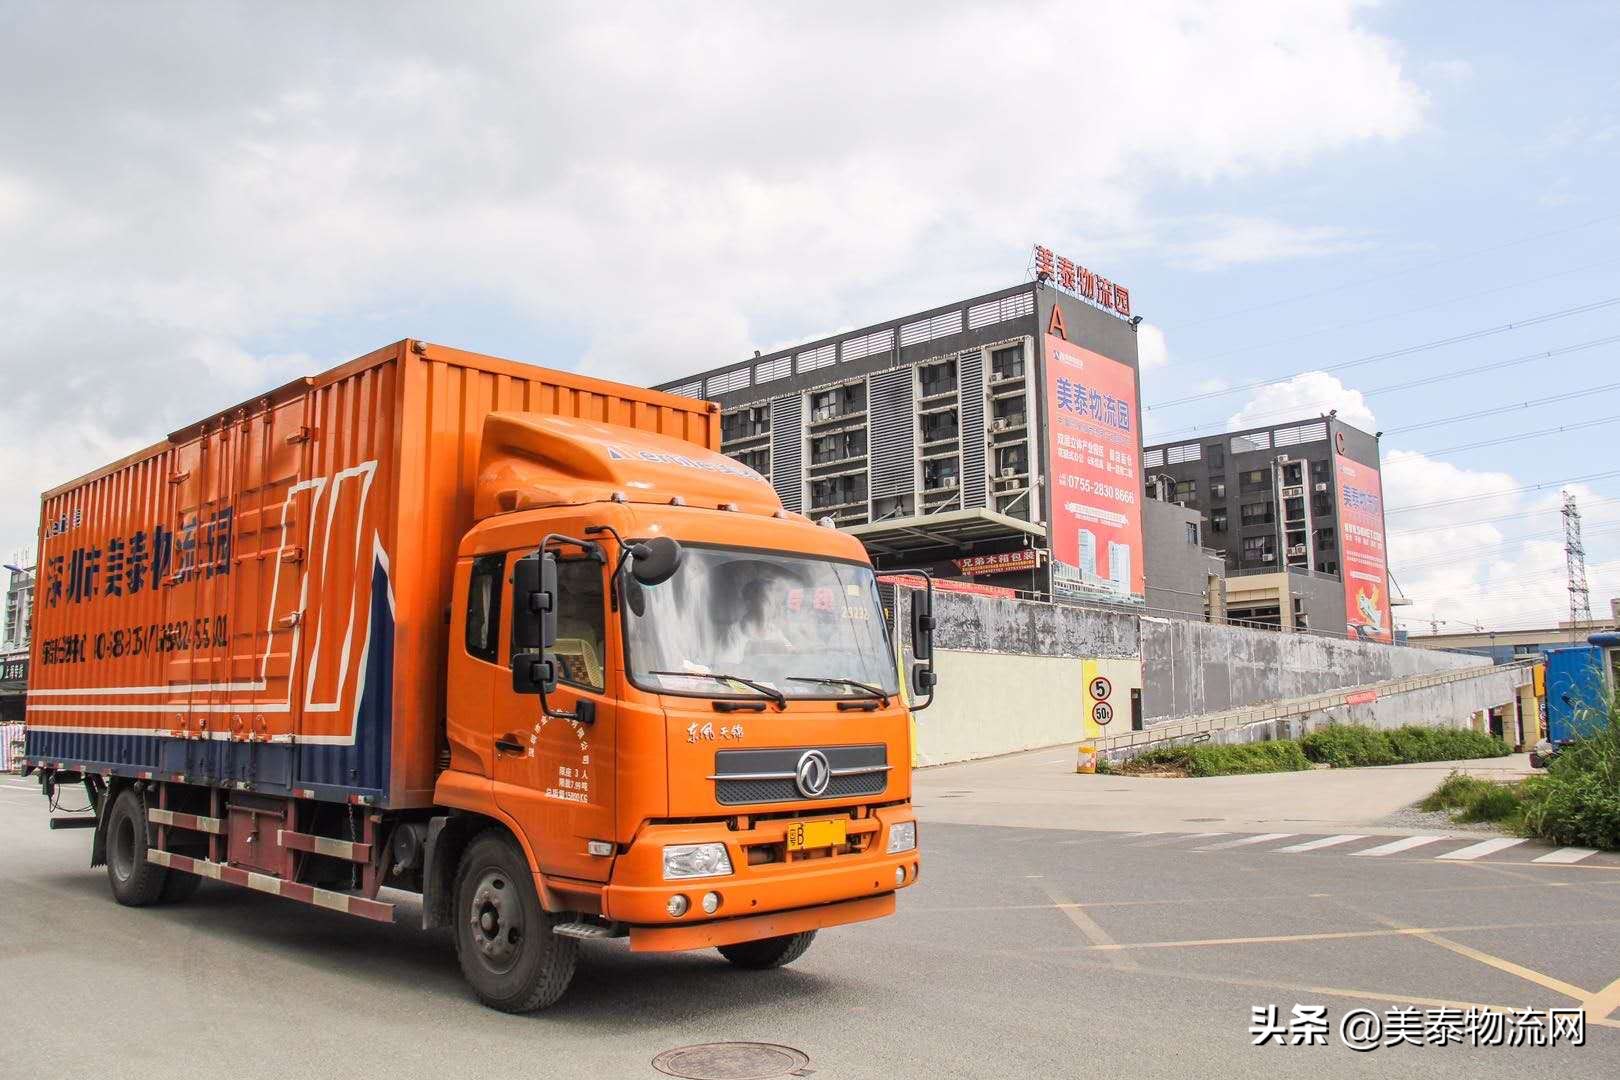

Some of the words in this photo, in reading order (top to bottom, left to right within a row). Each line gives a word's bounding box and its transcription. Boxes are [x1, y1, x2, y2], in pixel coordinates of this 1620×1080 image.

[1036, 244, 1130, 316] 美泰物流园
[1048, 303, 1067, 341] A
[1056, 376, 1129, 431] 美泰物流园
[1335, 431, 1345, 456] C
[1095, 680, 1107, 697] 5
[1096, 707, 1110, 720] 50t
